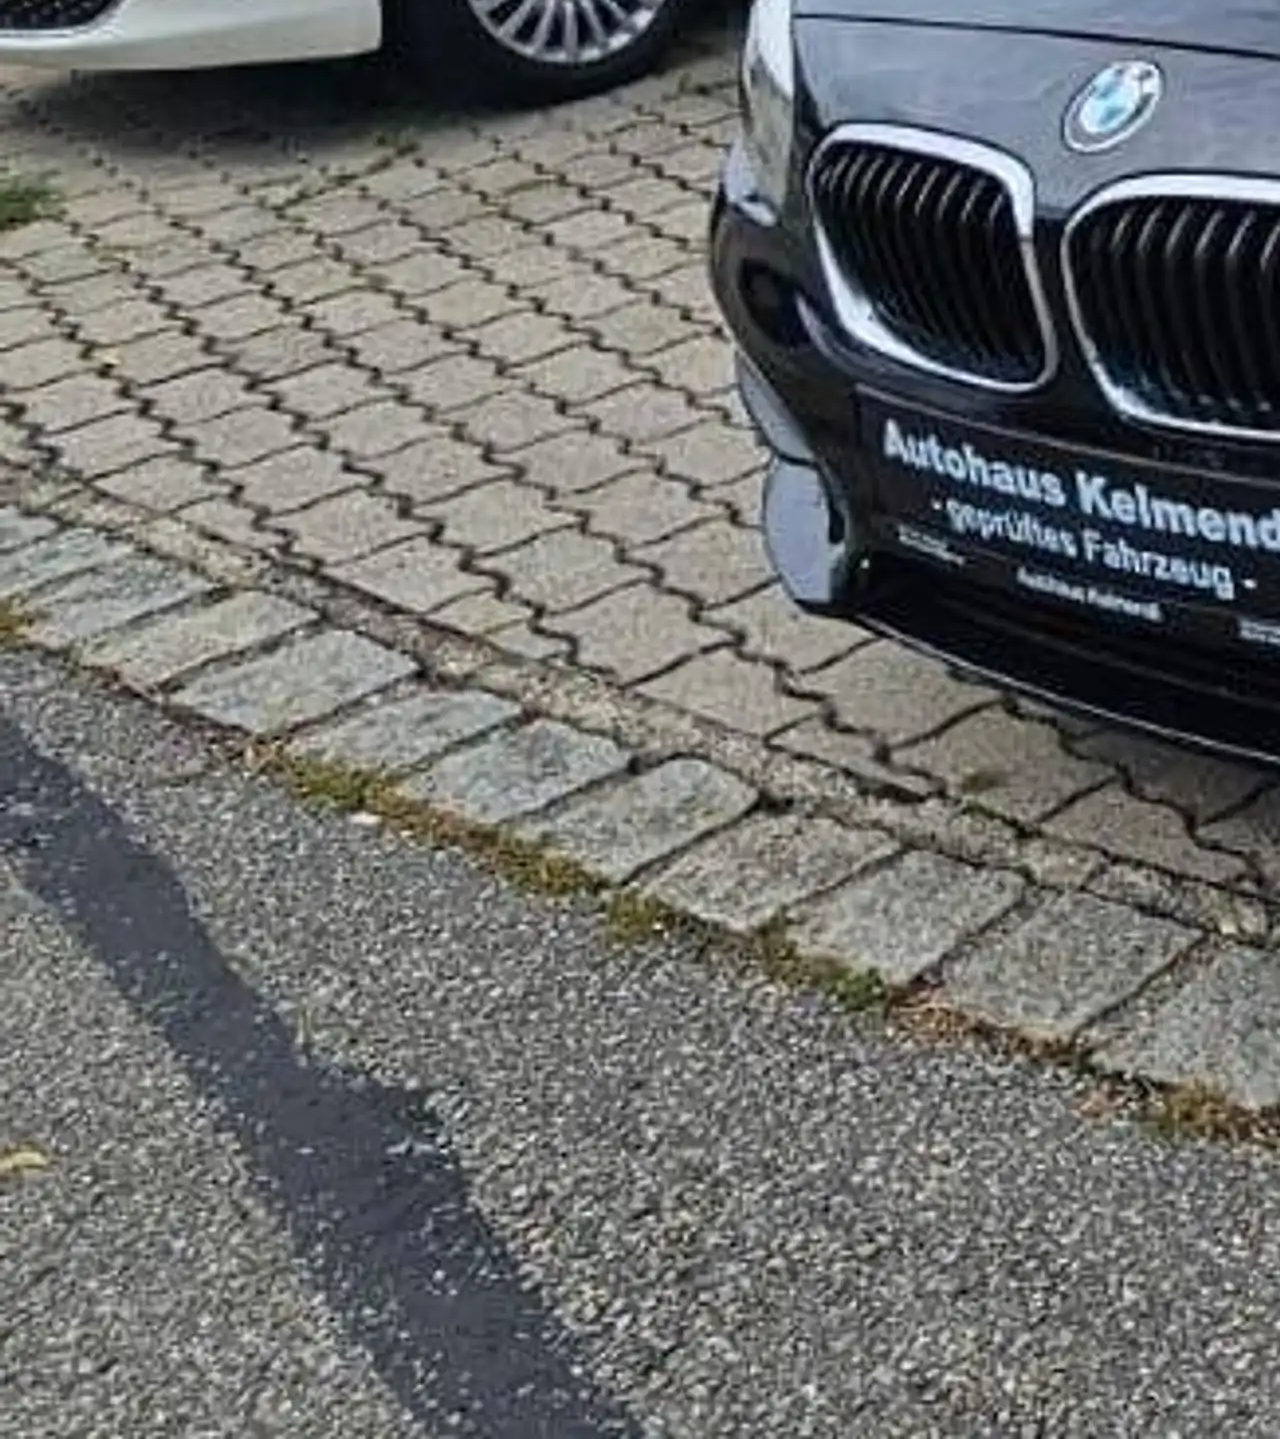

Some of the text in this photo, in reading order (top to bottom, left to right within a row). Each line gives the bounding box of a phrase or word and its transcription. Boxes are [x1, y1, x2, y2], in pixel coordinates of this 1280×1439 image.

[883, 418, 1066, 507] Autohaus
[946, 498, 1078, 559] geprüftes
[1083, 528, 1236, 602] Fahrzeug
